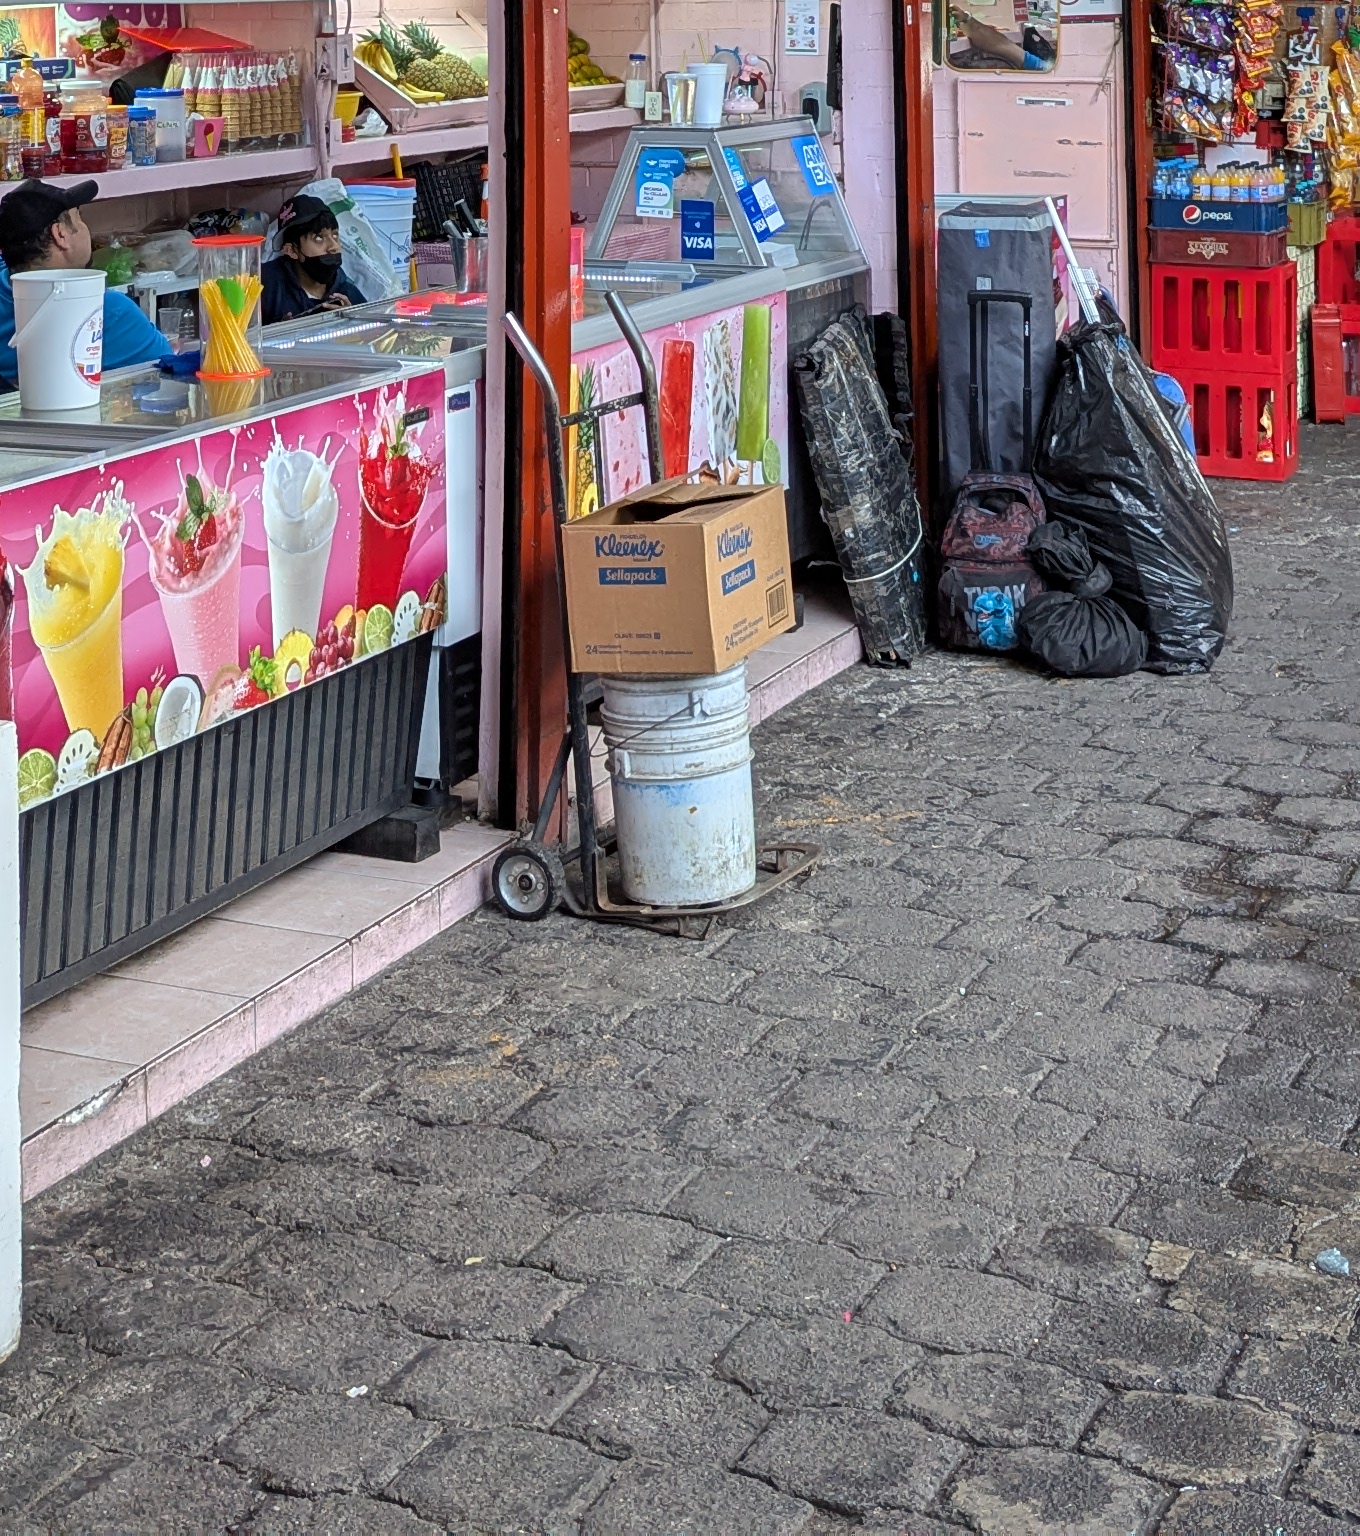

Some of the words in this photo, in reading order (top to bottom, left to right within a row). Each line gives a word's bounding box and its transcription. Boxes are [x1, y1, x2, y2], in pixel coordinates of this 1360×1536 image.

[1202, 211, 1232, 221] pepsi
[684, 236, 713, 249] VISA
[595, 533, 665, 561] Kleenex
[716, 526, 753, 562] Kleenex
[725, 633, 735, 651] 24
[586, 645, 598, 655] 24
